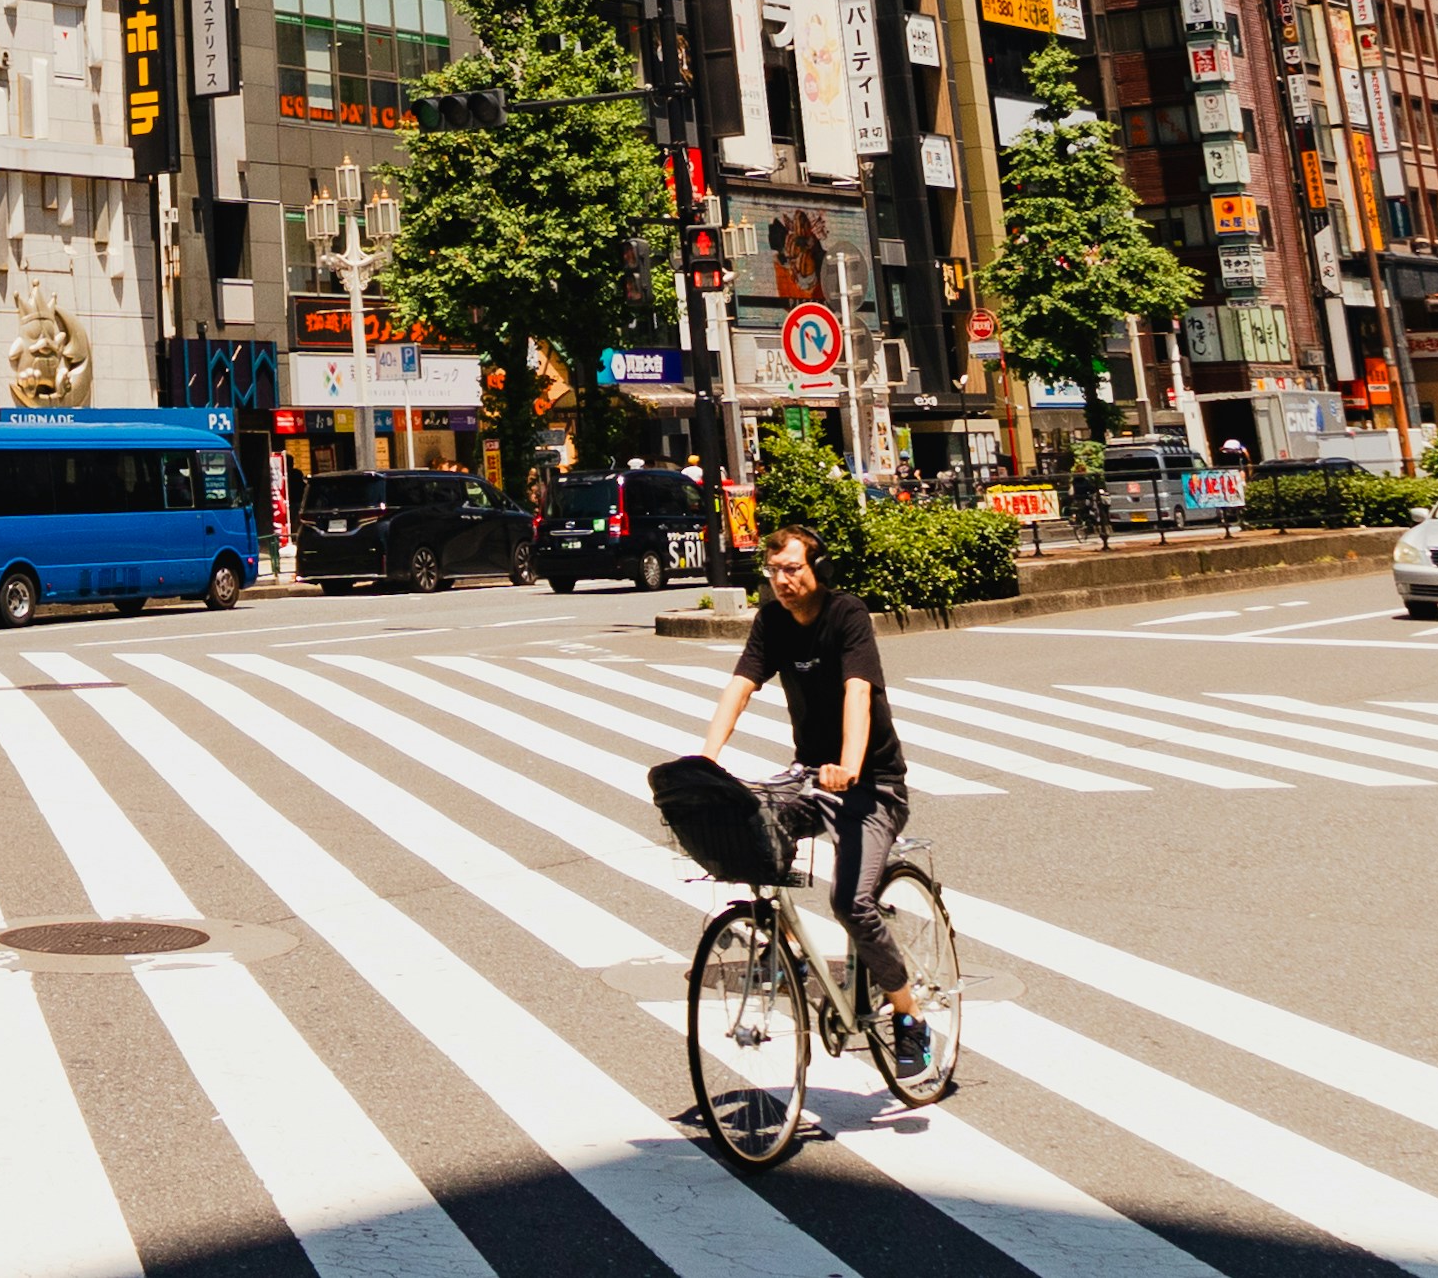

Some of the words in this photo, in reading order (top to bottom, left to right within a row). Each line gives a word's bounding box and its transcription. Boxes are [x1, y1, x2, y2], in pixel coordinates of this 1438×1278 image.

[847, 6, 874, 119] パーティー
[1285, 411, 1317, 433] CNG
